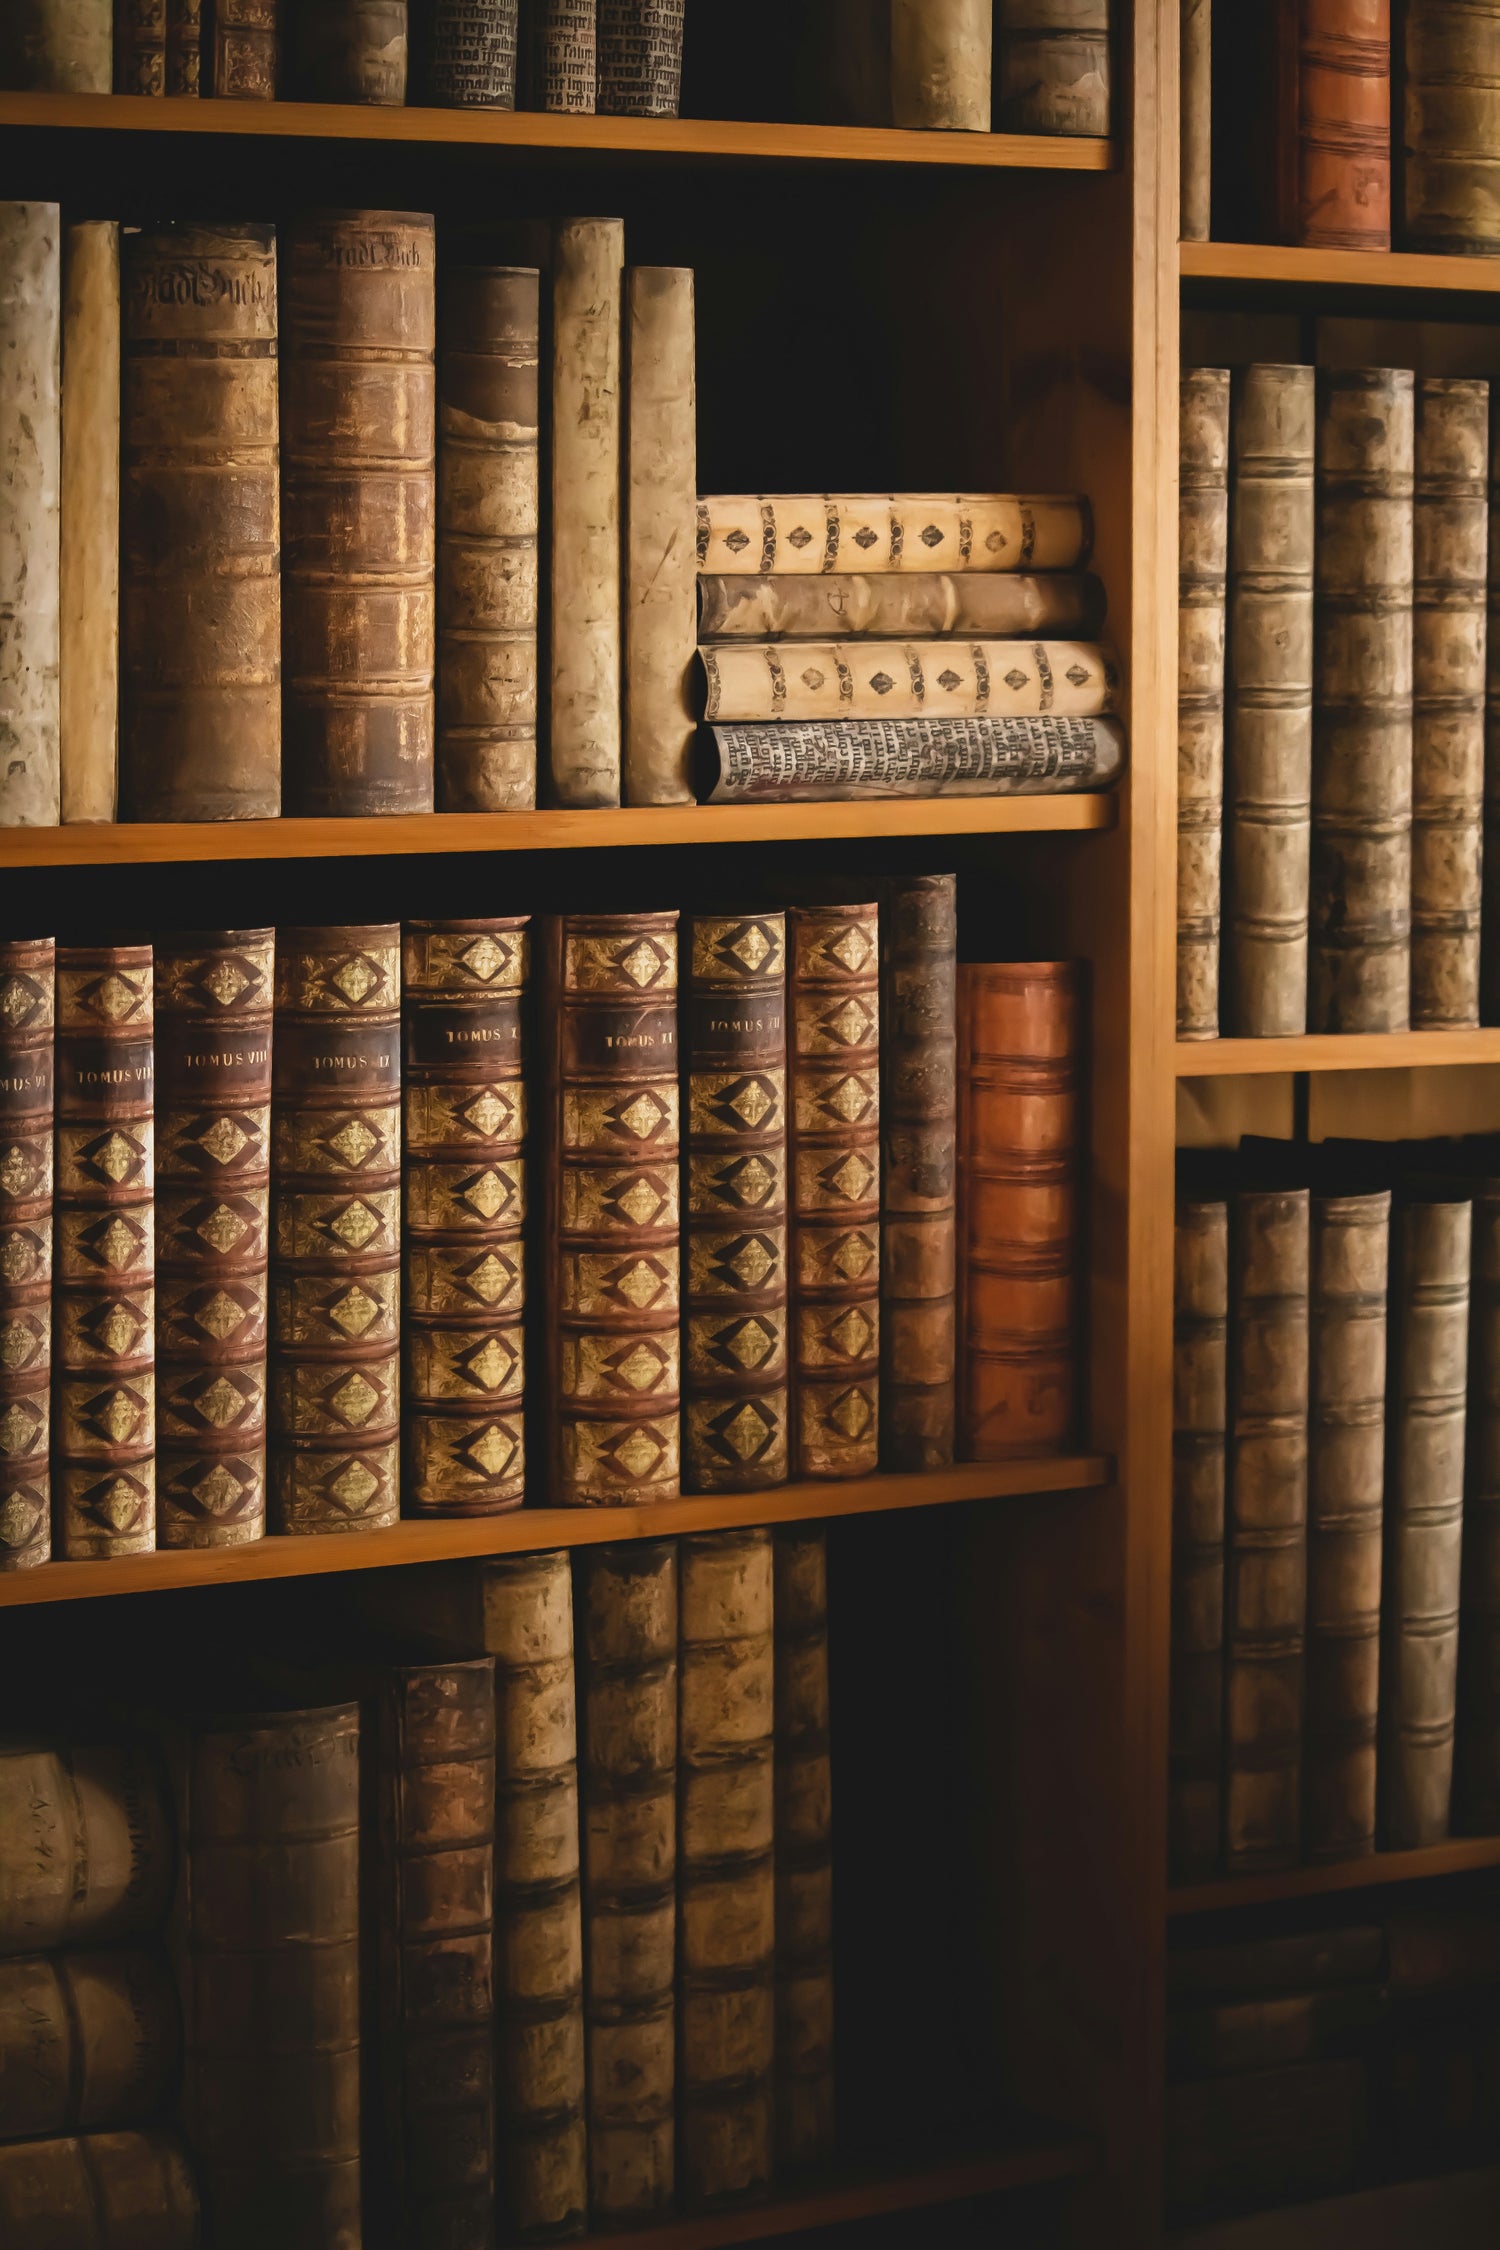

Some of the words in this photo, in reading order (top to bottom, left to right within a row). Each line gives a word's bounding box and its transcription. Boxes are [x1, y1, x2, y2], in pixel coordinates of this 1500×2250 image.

[710, 1019, 764, 1032] TOMUS
[446, 1027, 501, 1043] TOMUS
[605, 1034, 655, 1048] TOMUS
[661, 1032, 673, 1045] XI
[184, 1053, 243, 1069] TOMUS
[248, 1050, 268, 1065] VIII
[313, 1055, 368, 1069] TOMUS
[379, 1054, 391, 1068] IX
[77, 1069, 132, 1084] TOMUS
